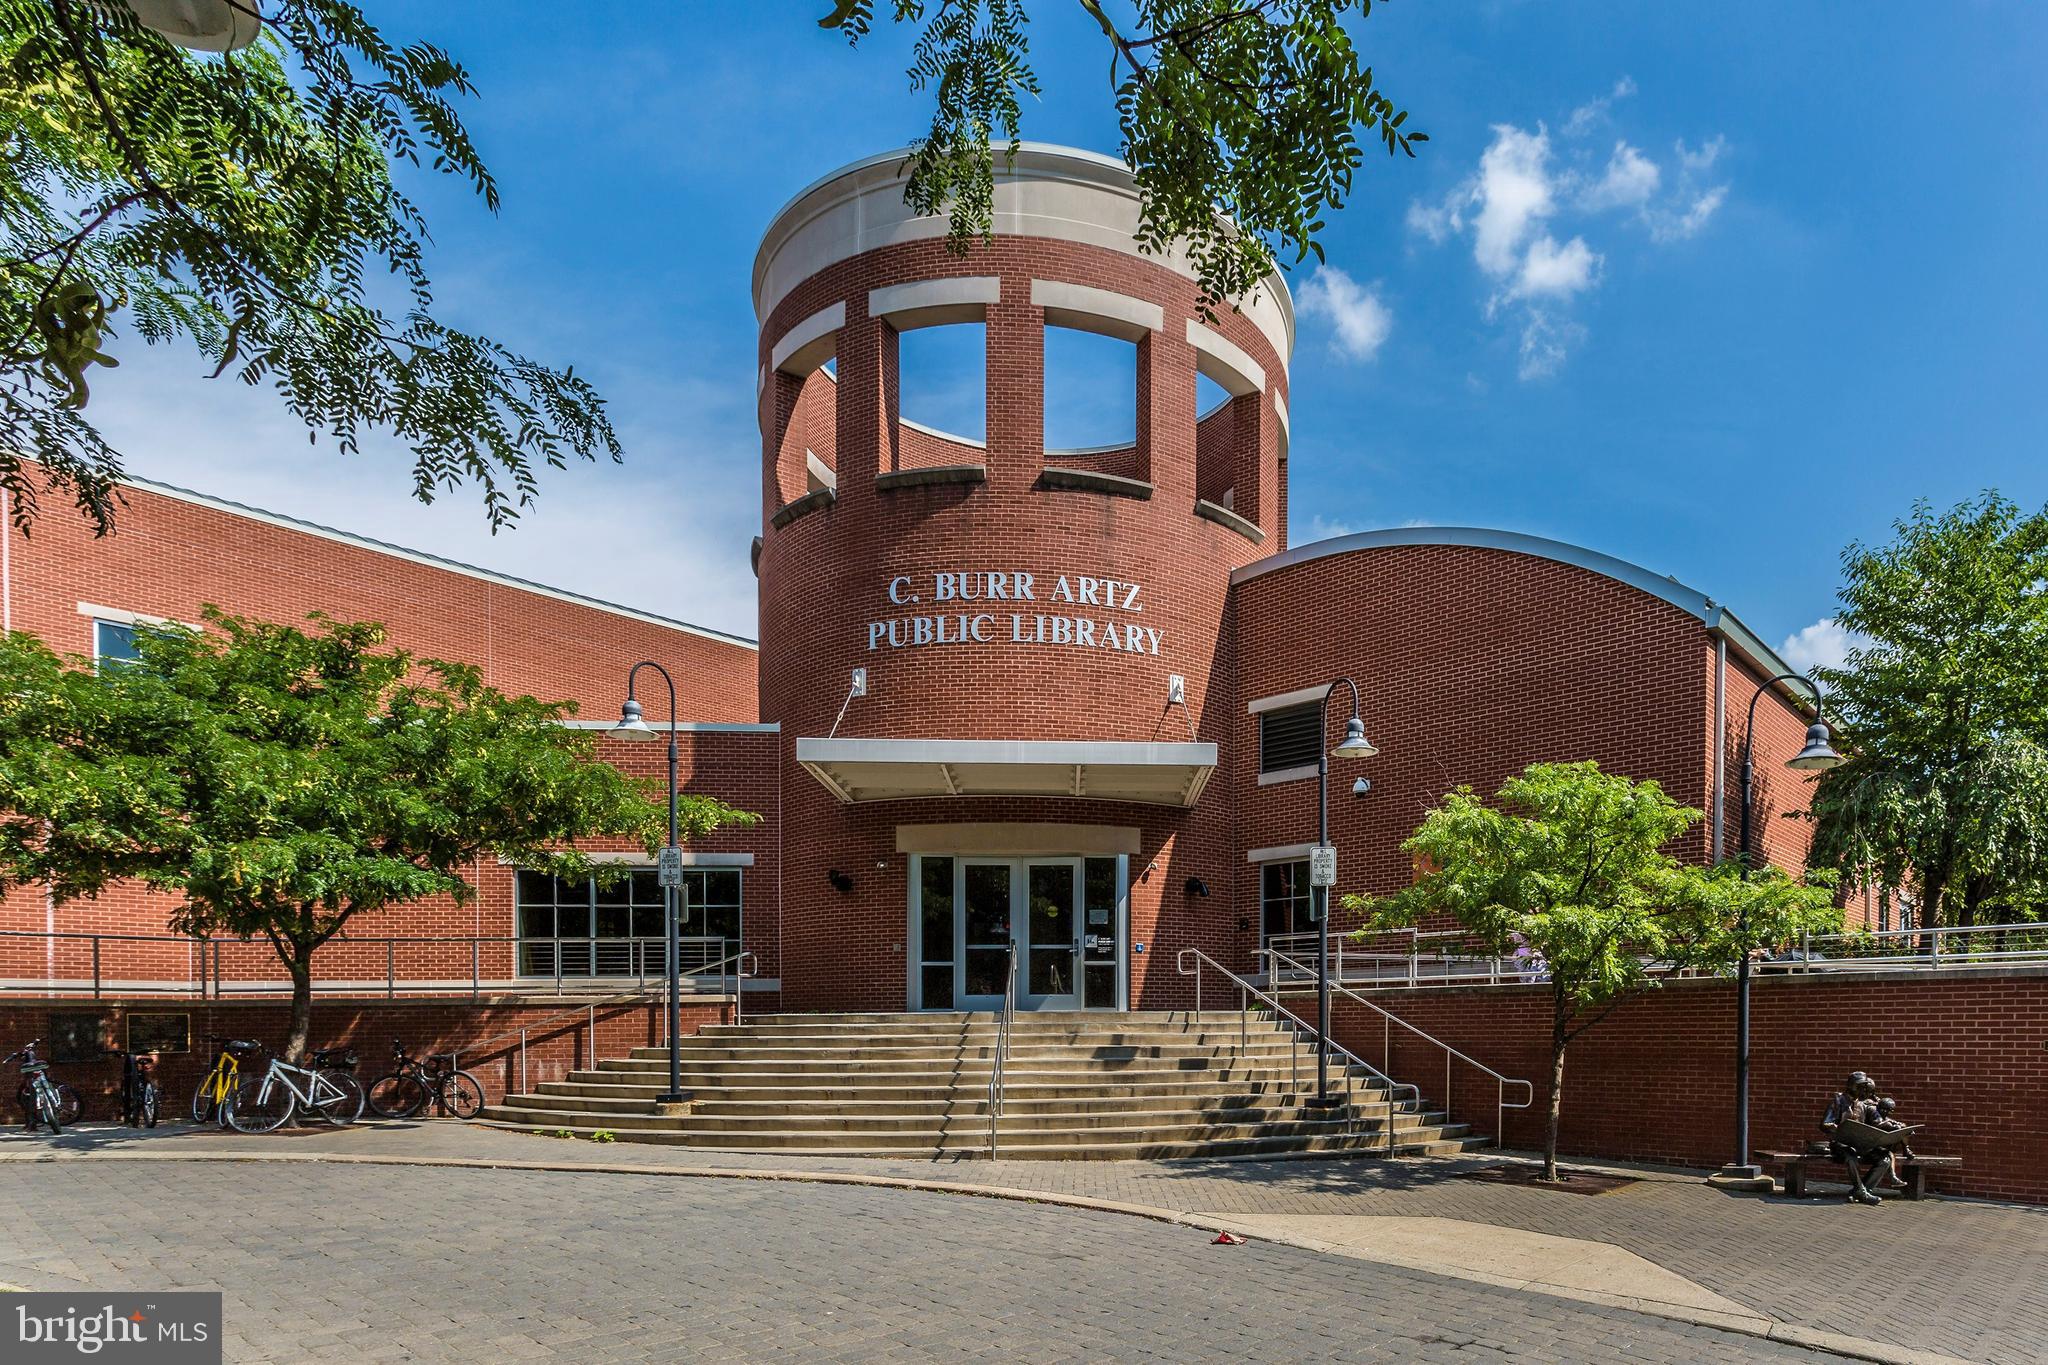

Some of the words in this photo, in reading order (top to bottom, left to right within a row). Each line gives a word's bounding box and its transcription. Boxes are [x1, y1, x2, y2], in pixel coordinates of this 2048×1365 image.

[889, 576, 919, 605] C.
[933, 571, 1035, 602] BURR
[1050, 574, 1143, 612] ARTZ
[867, 614, 995, 650] PUBLIC
[1010, 614, 1165, 656] LIBRARY
